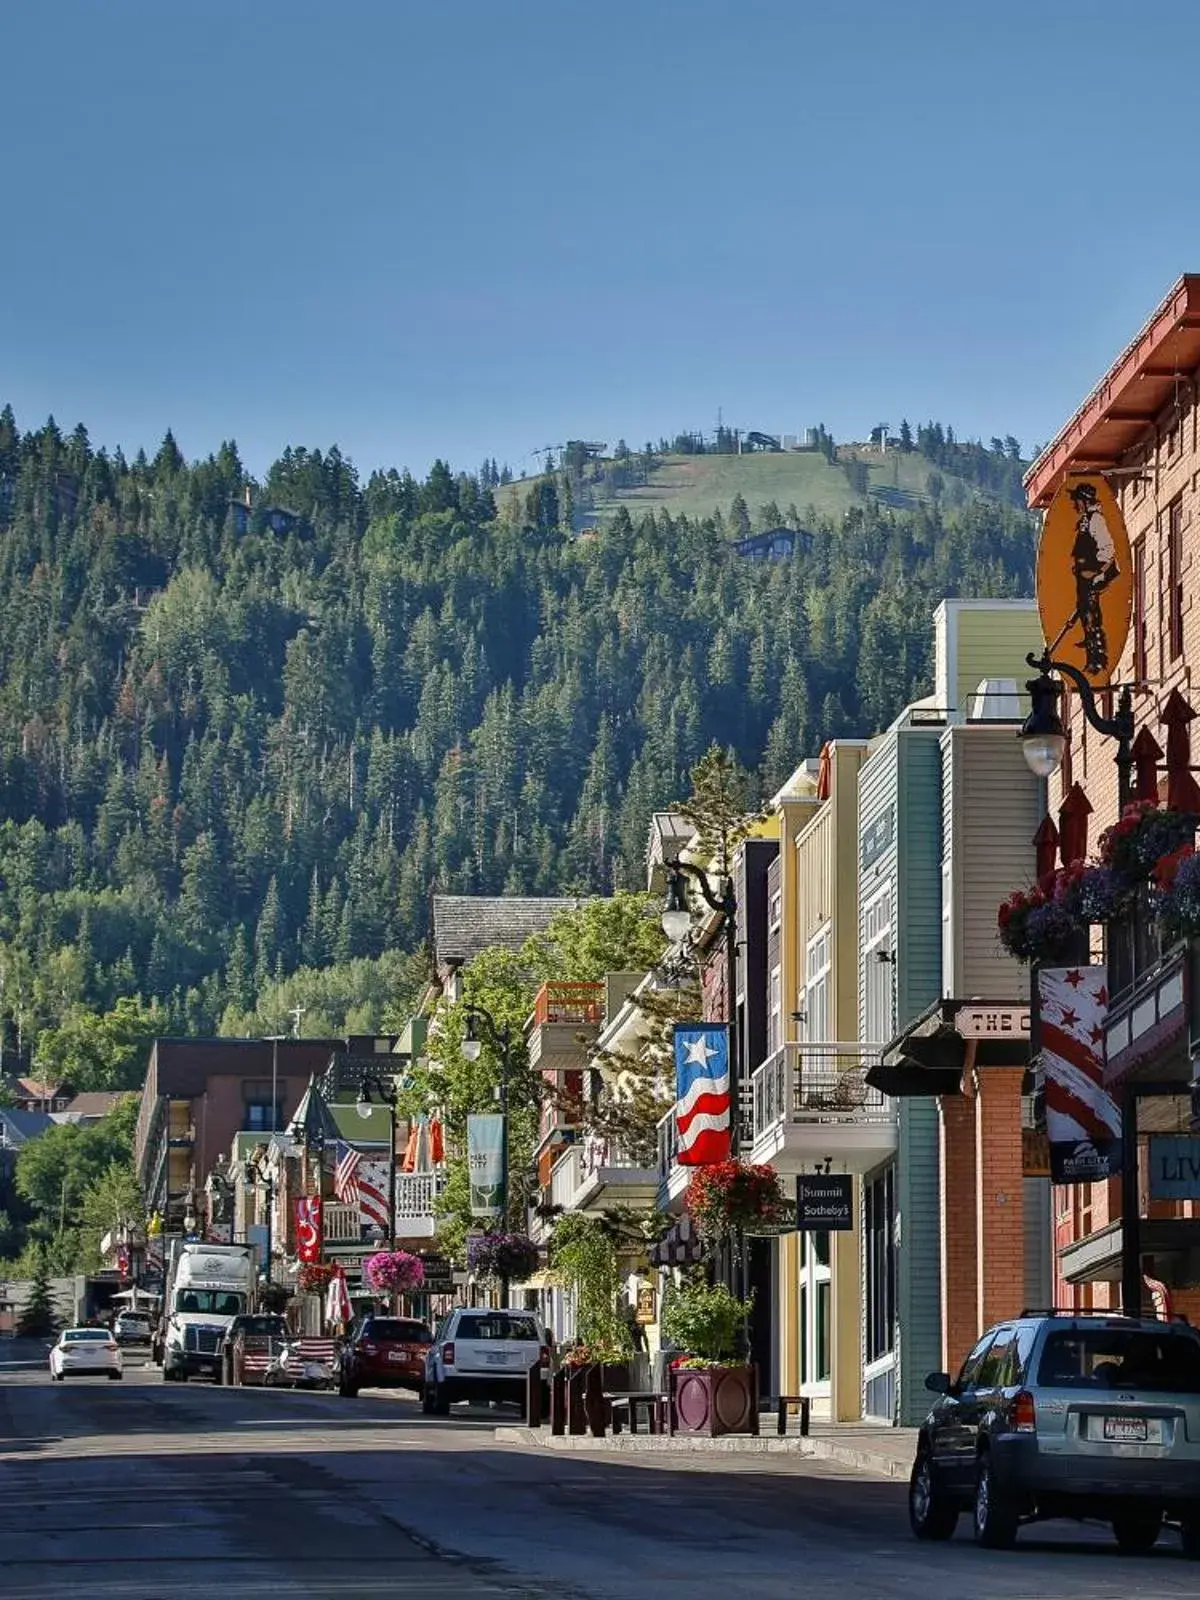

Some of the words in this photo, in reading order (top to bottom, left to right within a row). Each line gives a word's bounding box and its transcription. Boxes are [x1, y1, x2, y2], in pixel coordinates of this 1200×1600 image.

[972, 1014, 1012, 1031] THE
[804, 1186, 842, 1198] Summit
[803, 1204, 850, 1217] Sotheby's
